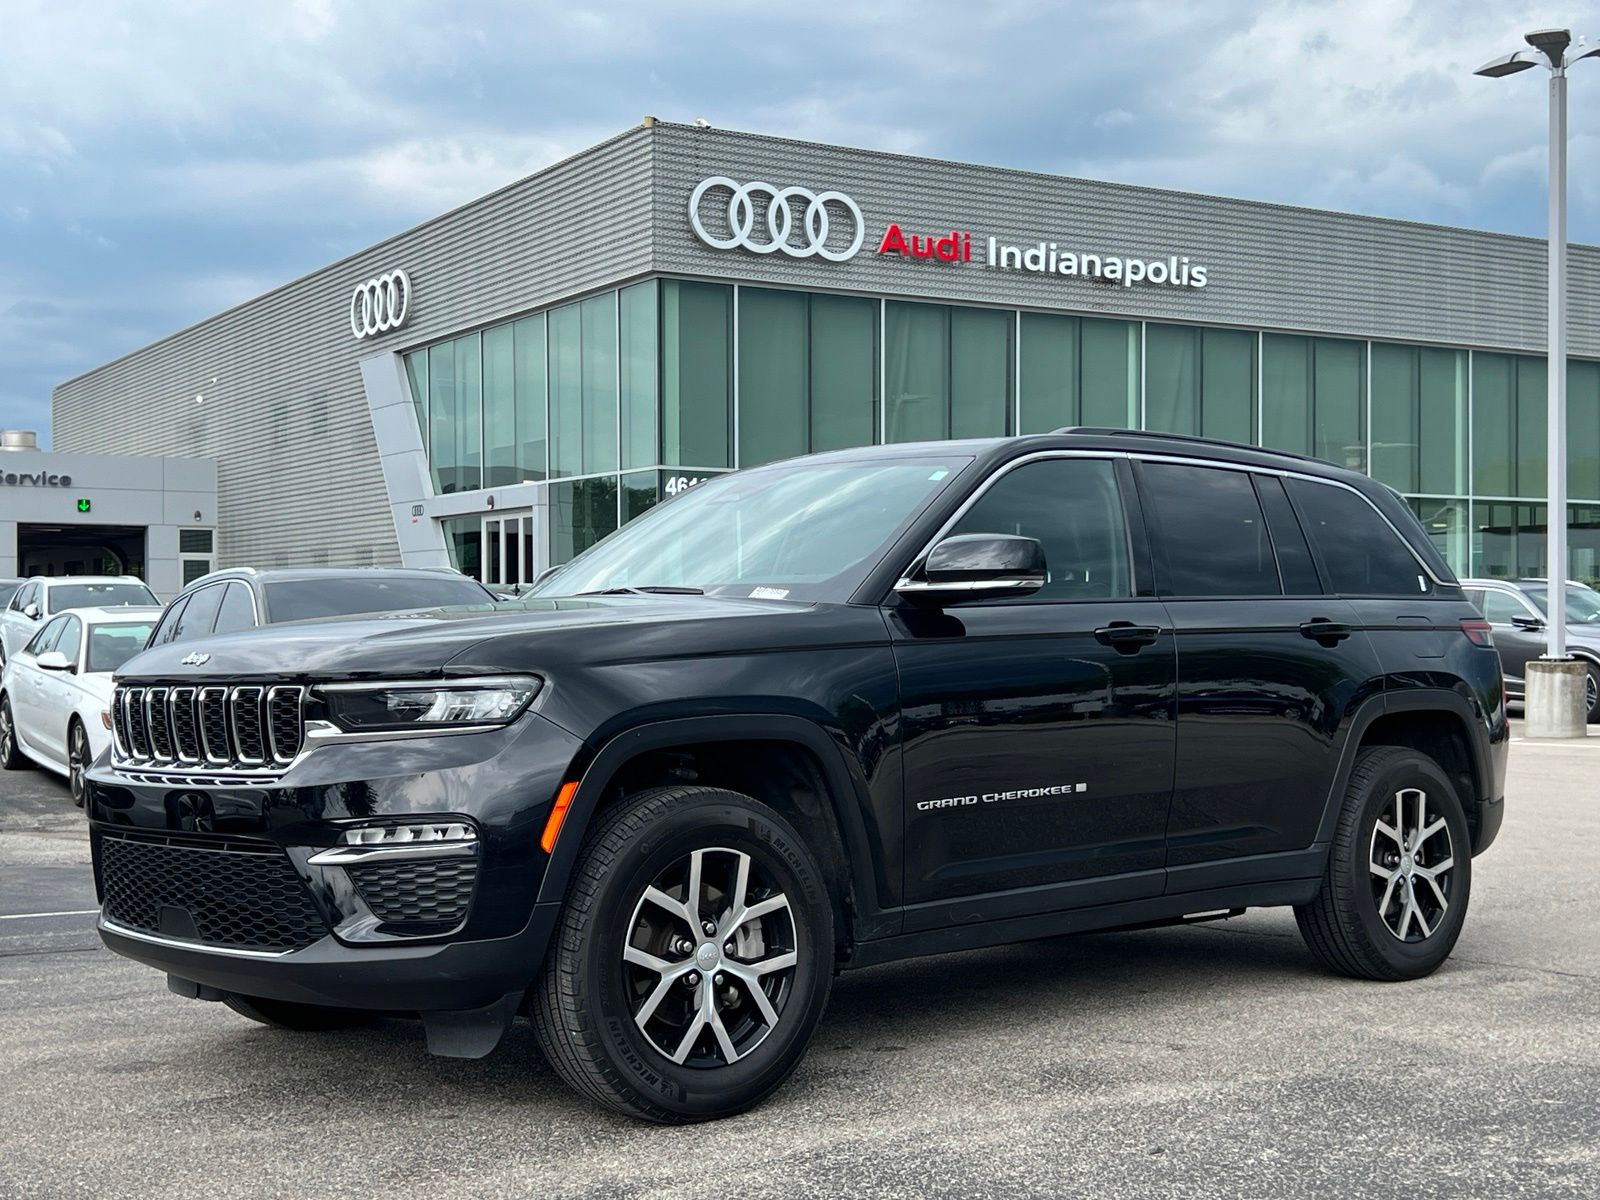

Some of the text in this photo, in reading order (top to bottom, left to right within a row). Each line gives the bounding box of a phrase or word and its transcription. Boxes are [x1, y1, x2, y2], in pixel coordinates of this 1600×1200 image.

[878, 223, 1208, 288] Audi Indianapolis
[0, 469, 72, 487] ervice
[665, 476, 708, 496] 46
[181, 650, 211, 667] Jeep
[916, 784, 1072, 811] GRAND CHEROKEE
[607, 1019, 660, 1087] MICHELIN
